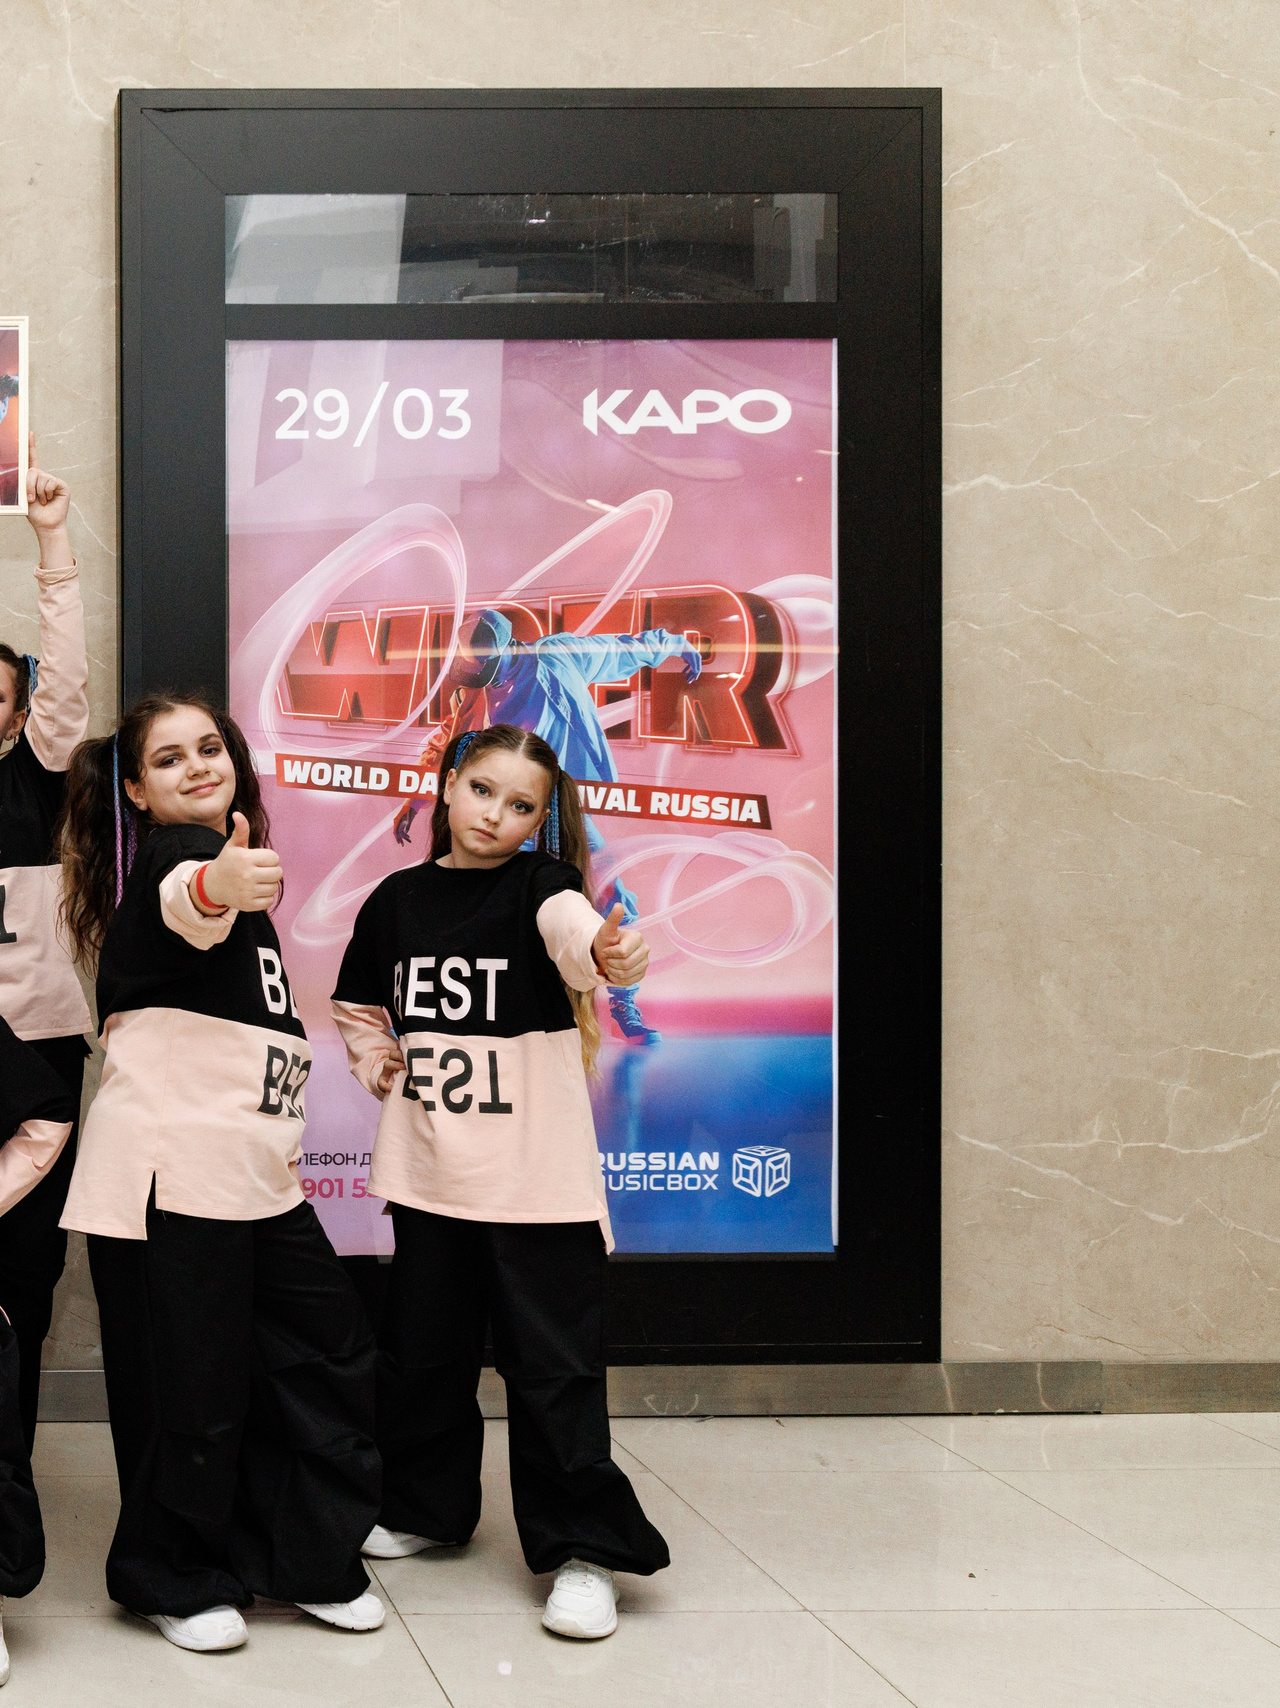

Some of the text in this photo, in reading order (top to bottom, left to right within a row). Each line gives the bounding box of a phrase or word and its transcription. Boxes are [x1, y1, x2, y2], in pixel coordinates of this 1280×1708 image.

[274, 381, 472, 447] 29/03
[283, 759, 390, 791] WORLD
[650, 791, 762, 823] RUSSIA
[297, 1152, 357, 1167] ЛЕФОН
[302, 1177, 344, 1199] 901
[602, 1174, 719, 1191] USICBOX
